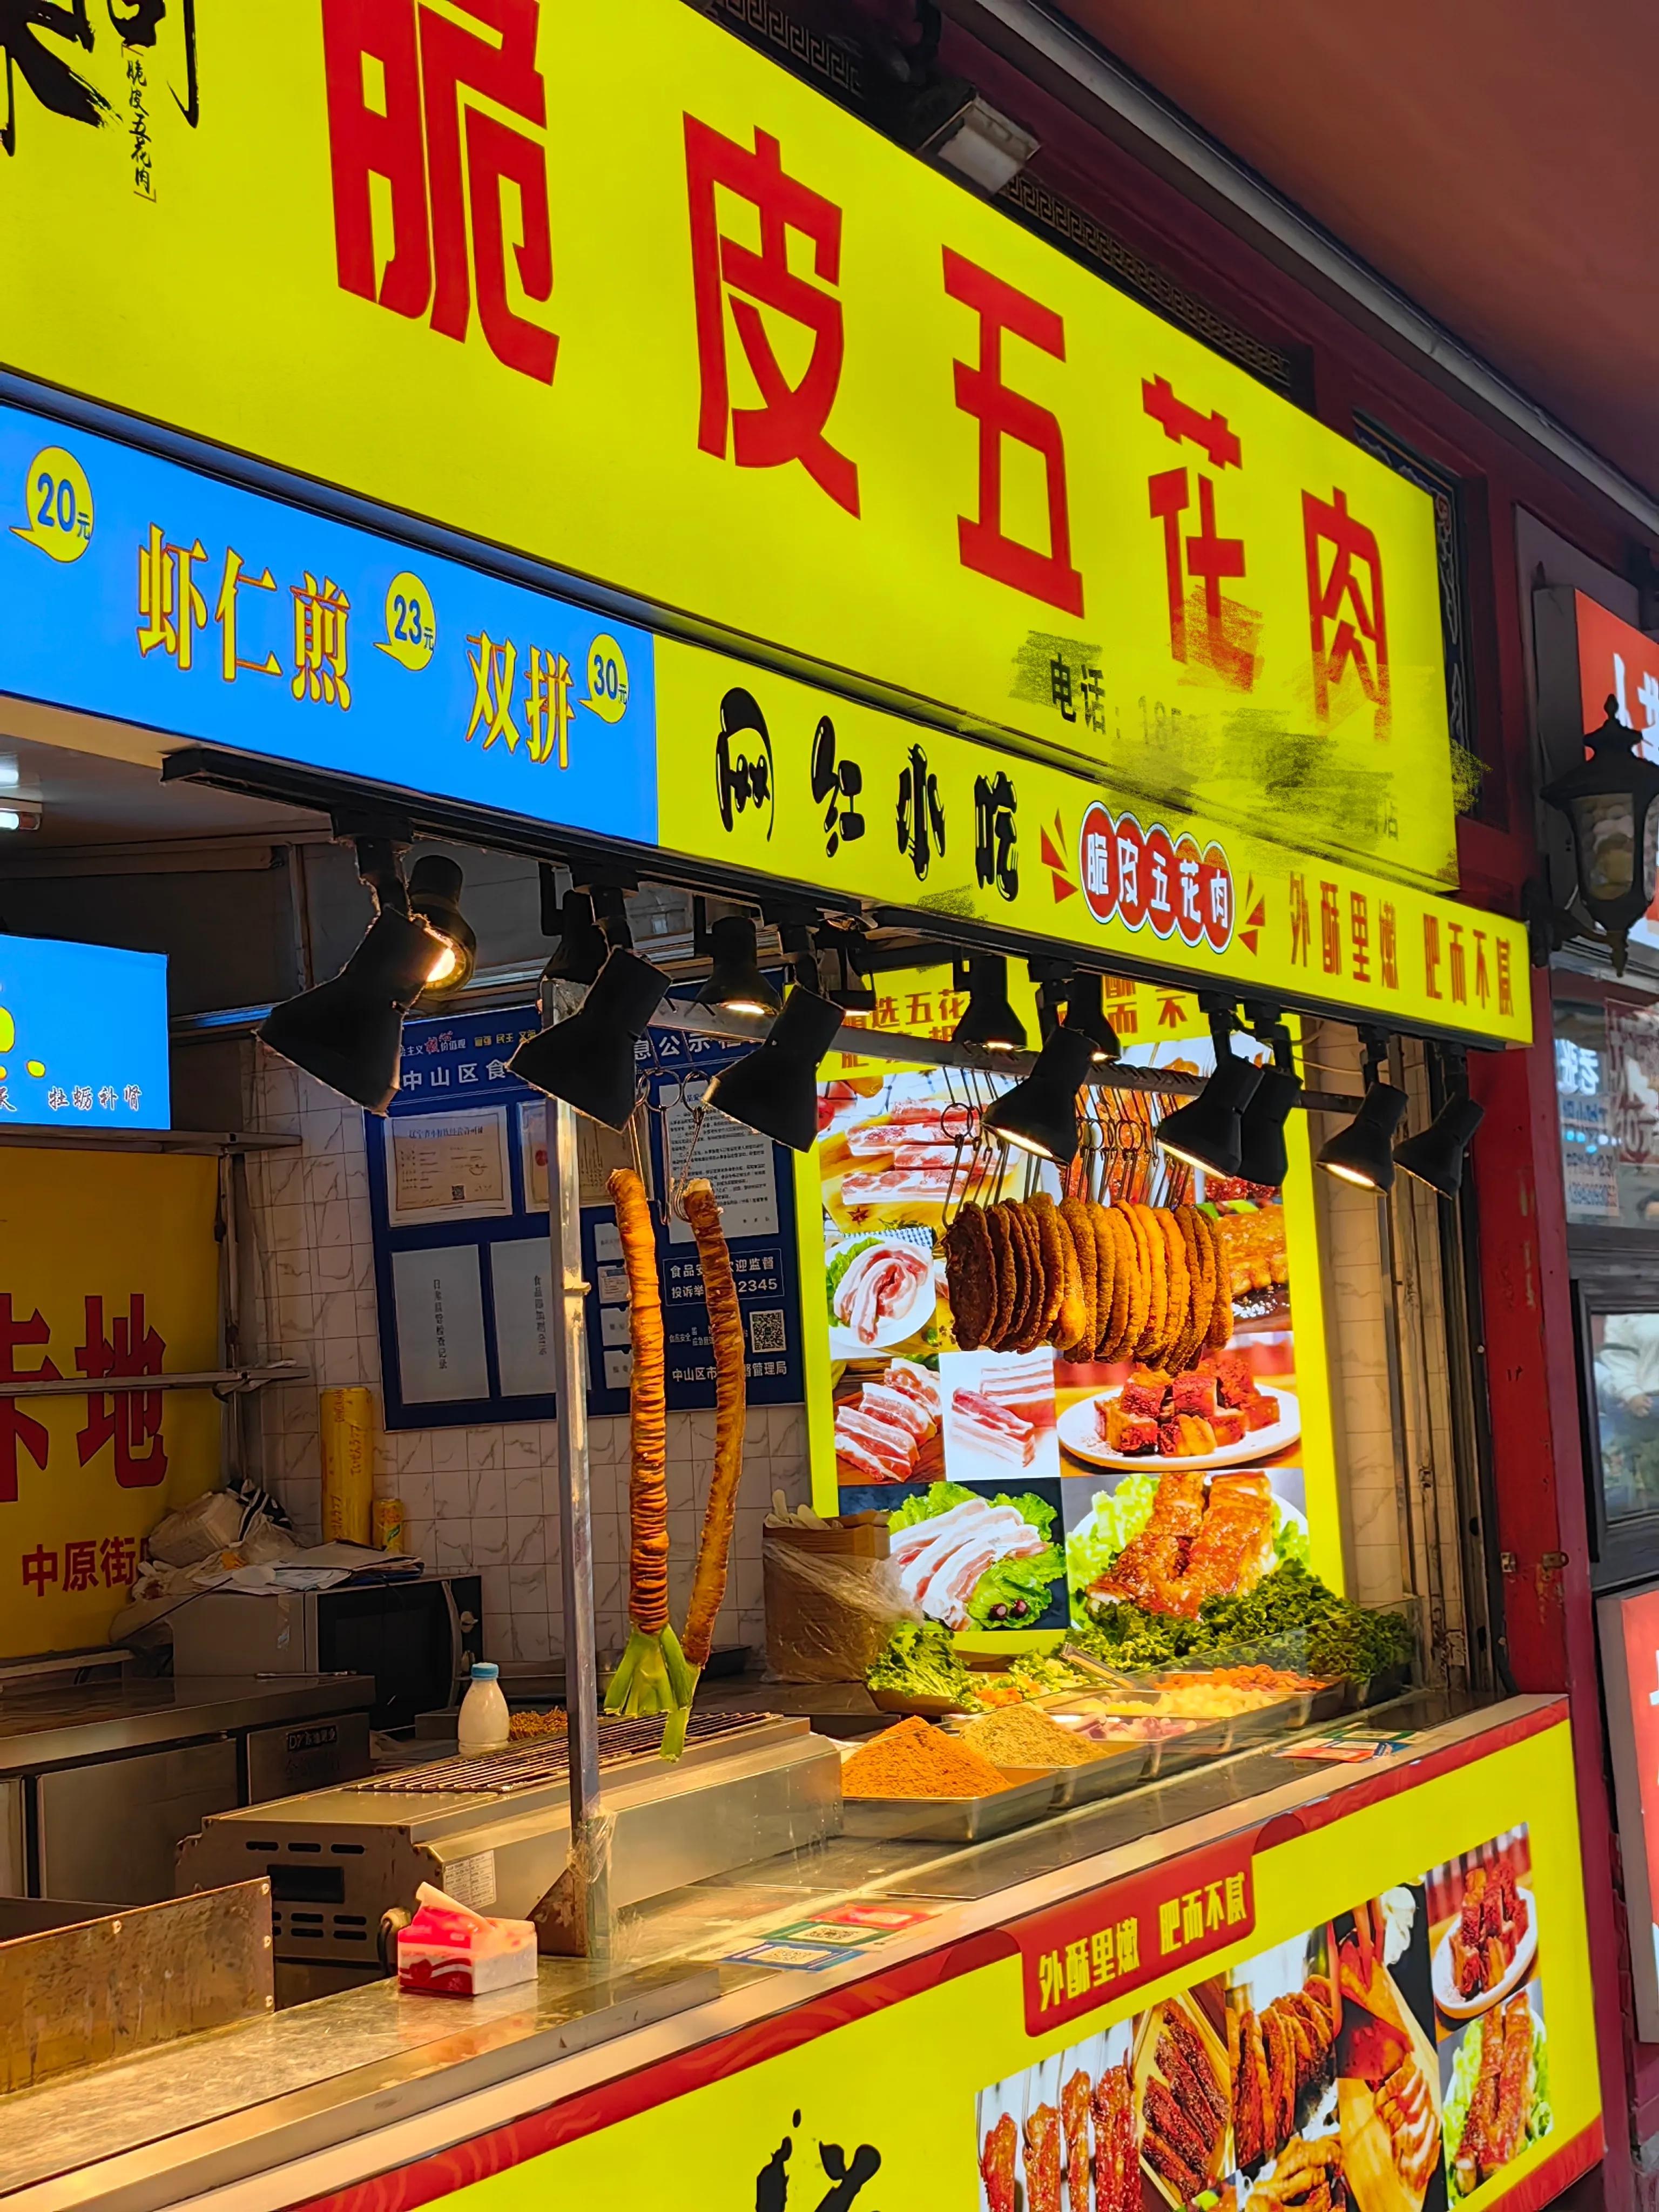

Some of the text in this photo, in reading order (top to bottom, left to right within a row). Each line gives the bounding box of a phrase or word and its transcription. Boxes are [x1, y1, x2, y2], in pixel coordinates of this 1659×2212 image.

[322, 0, 1392, 743] 脆皮五花肉
[36, 472, 91, 541] 20元
[137, 522, 352, 712] 虾仁煎
[393, 596, 435, 652] 23元
[465, 630, 576, 771] 双拼
[716, 686, 1019, 902] 网红小吃
[1087, 832, 1229, 930] 脆皮五花肉
[1039, 1917, 1139, 2012] 外酥里嫩
